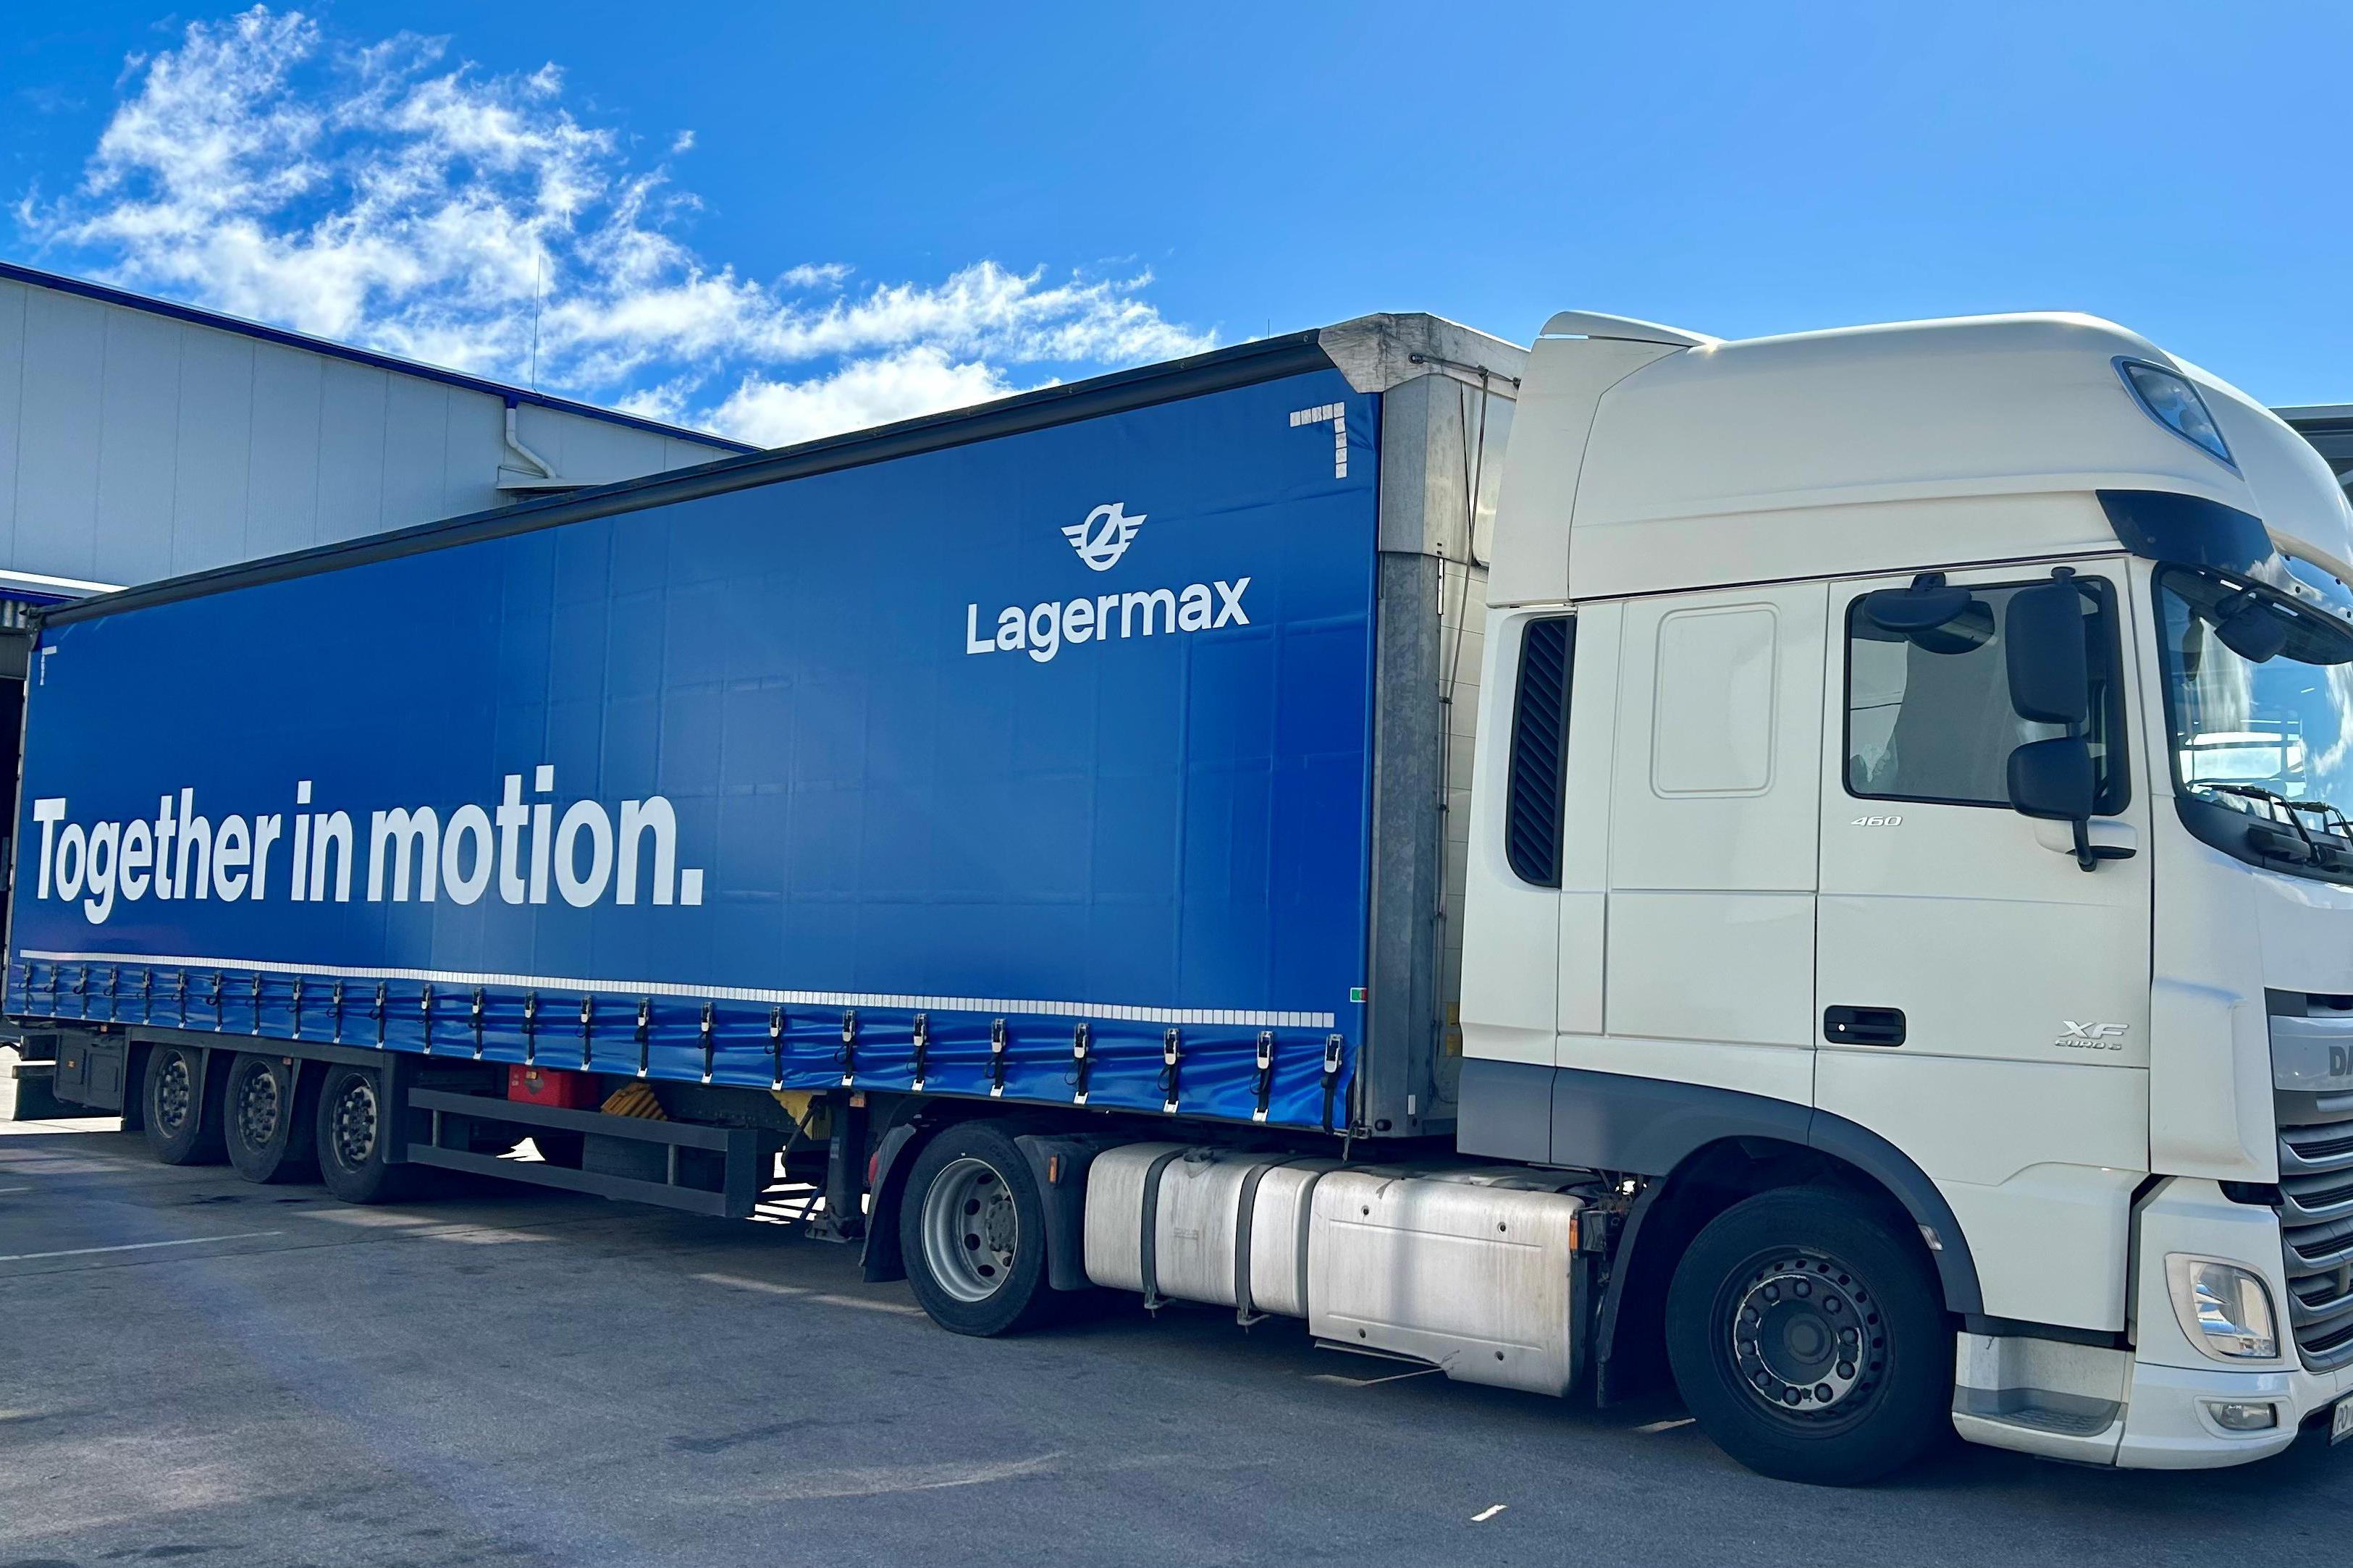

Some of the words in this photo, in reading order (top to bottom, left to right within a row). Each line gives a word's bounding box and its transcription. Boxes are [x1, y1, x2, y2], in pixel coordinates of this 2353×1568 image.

[967, 577, 1251, 663] Lagermax
[1851, 815, 1903, 827] 460
[33, 787, 281, 924] Together
[290, 780, 353, 903] in
[367, 764, 704, 908] motion.
[2058, 1019, 2129, 1040] XF
[2055, 1040, 2105, 1050] EURO
